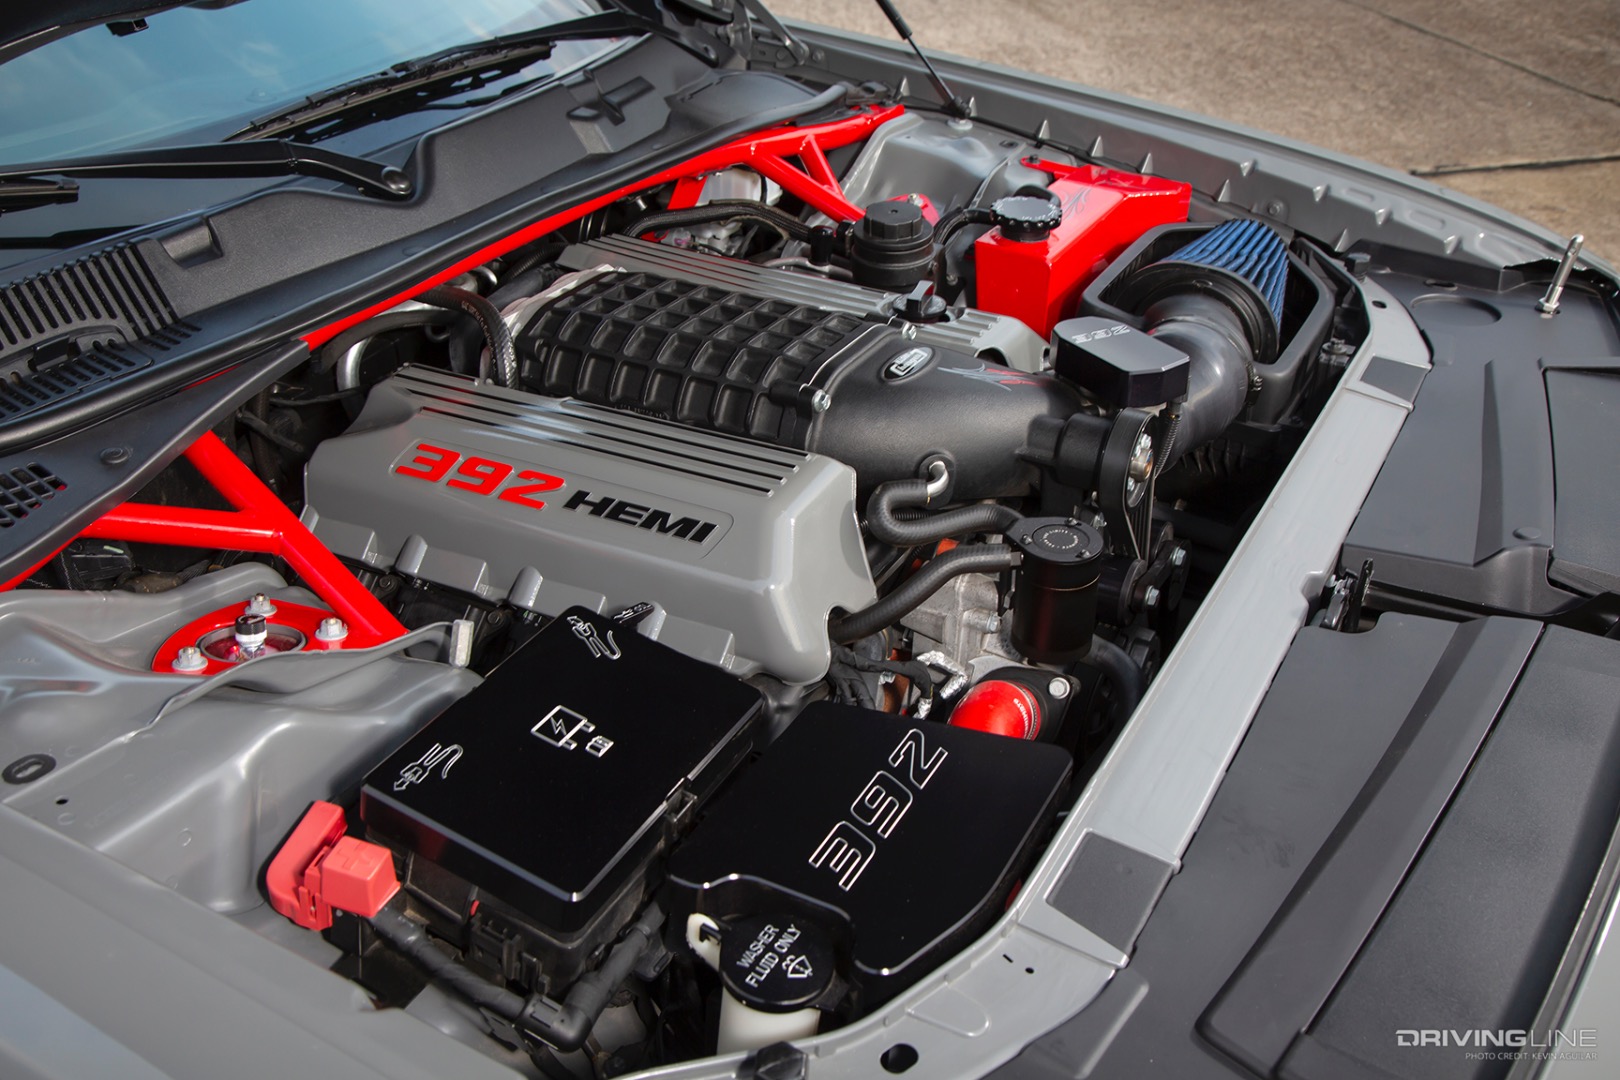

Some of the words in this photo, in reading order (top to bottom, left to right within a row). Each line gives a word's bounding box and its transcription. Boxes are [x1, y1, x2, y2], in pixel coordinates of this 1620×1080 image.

[394, 443, 566, 511] 392
[562, 489, 718, 543] HEMI
[808, 728, 948, 891] 392
[736, 924, 780, 968] WASHER
[745, 952, 779, 988] FLUID
[774, 923, 802, 953] ONLY
